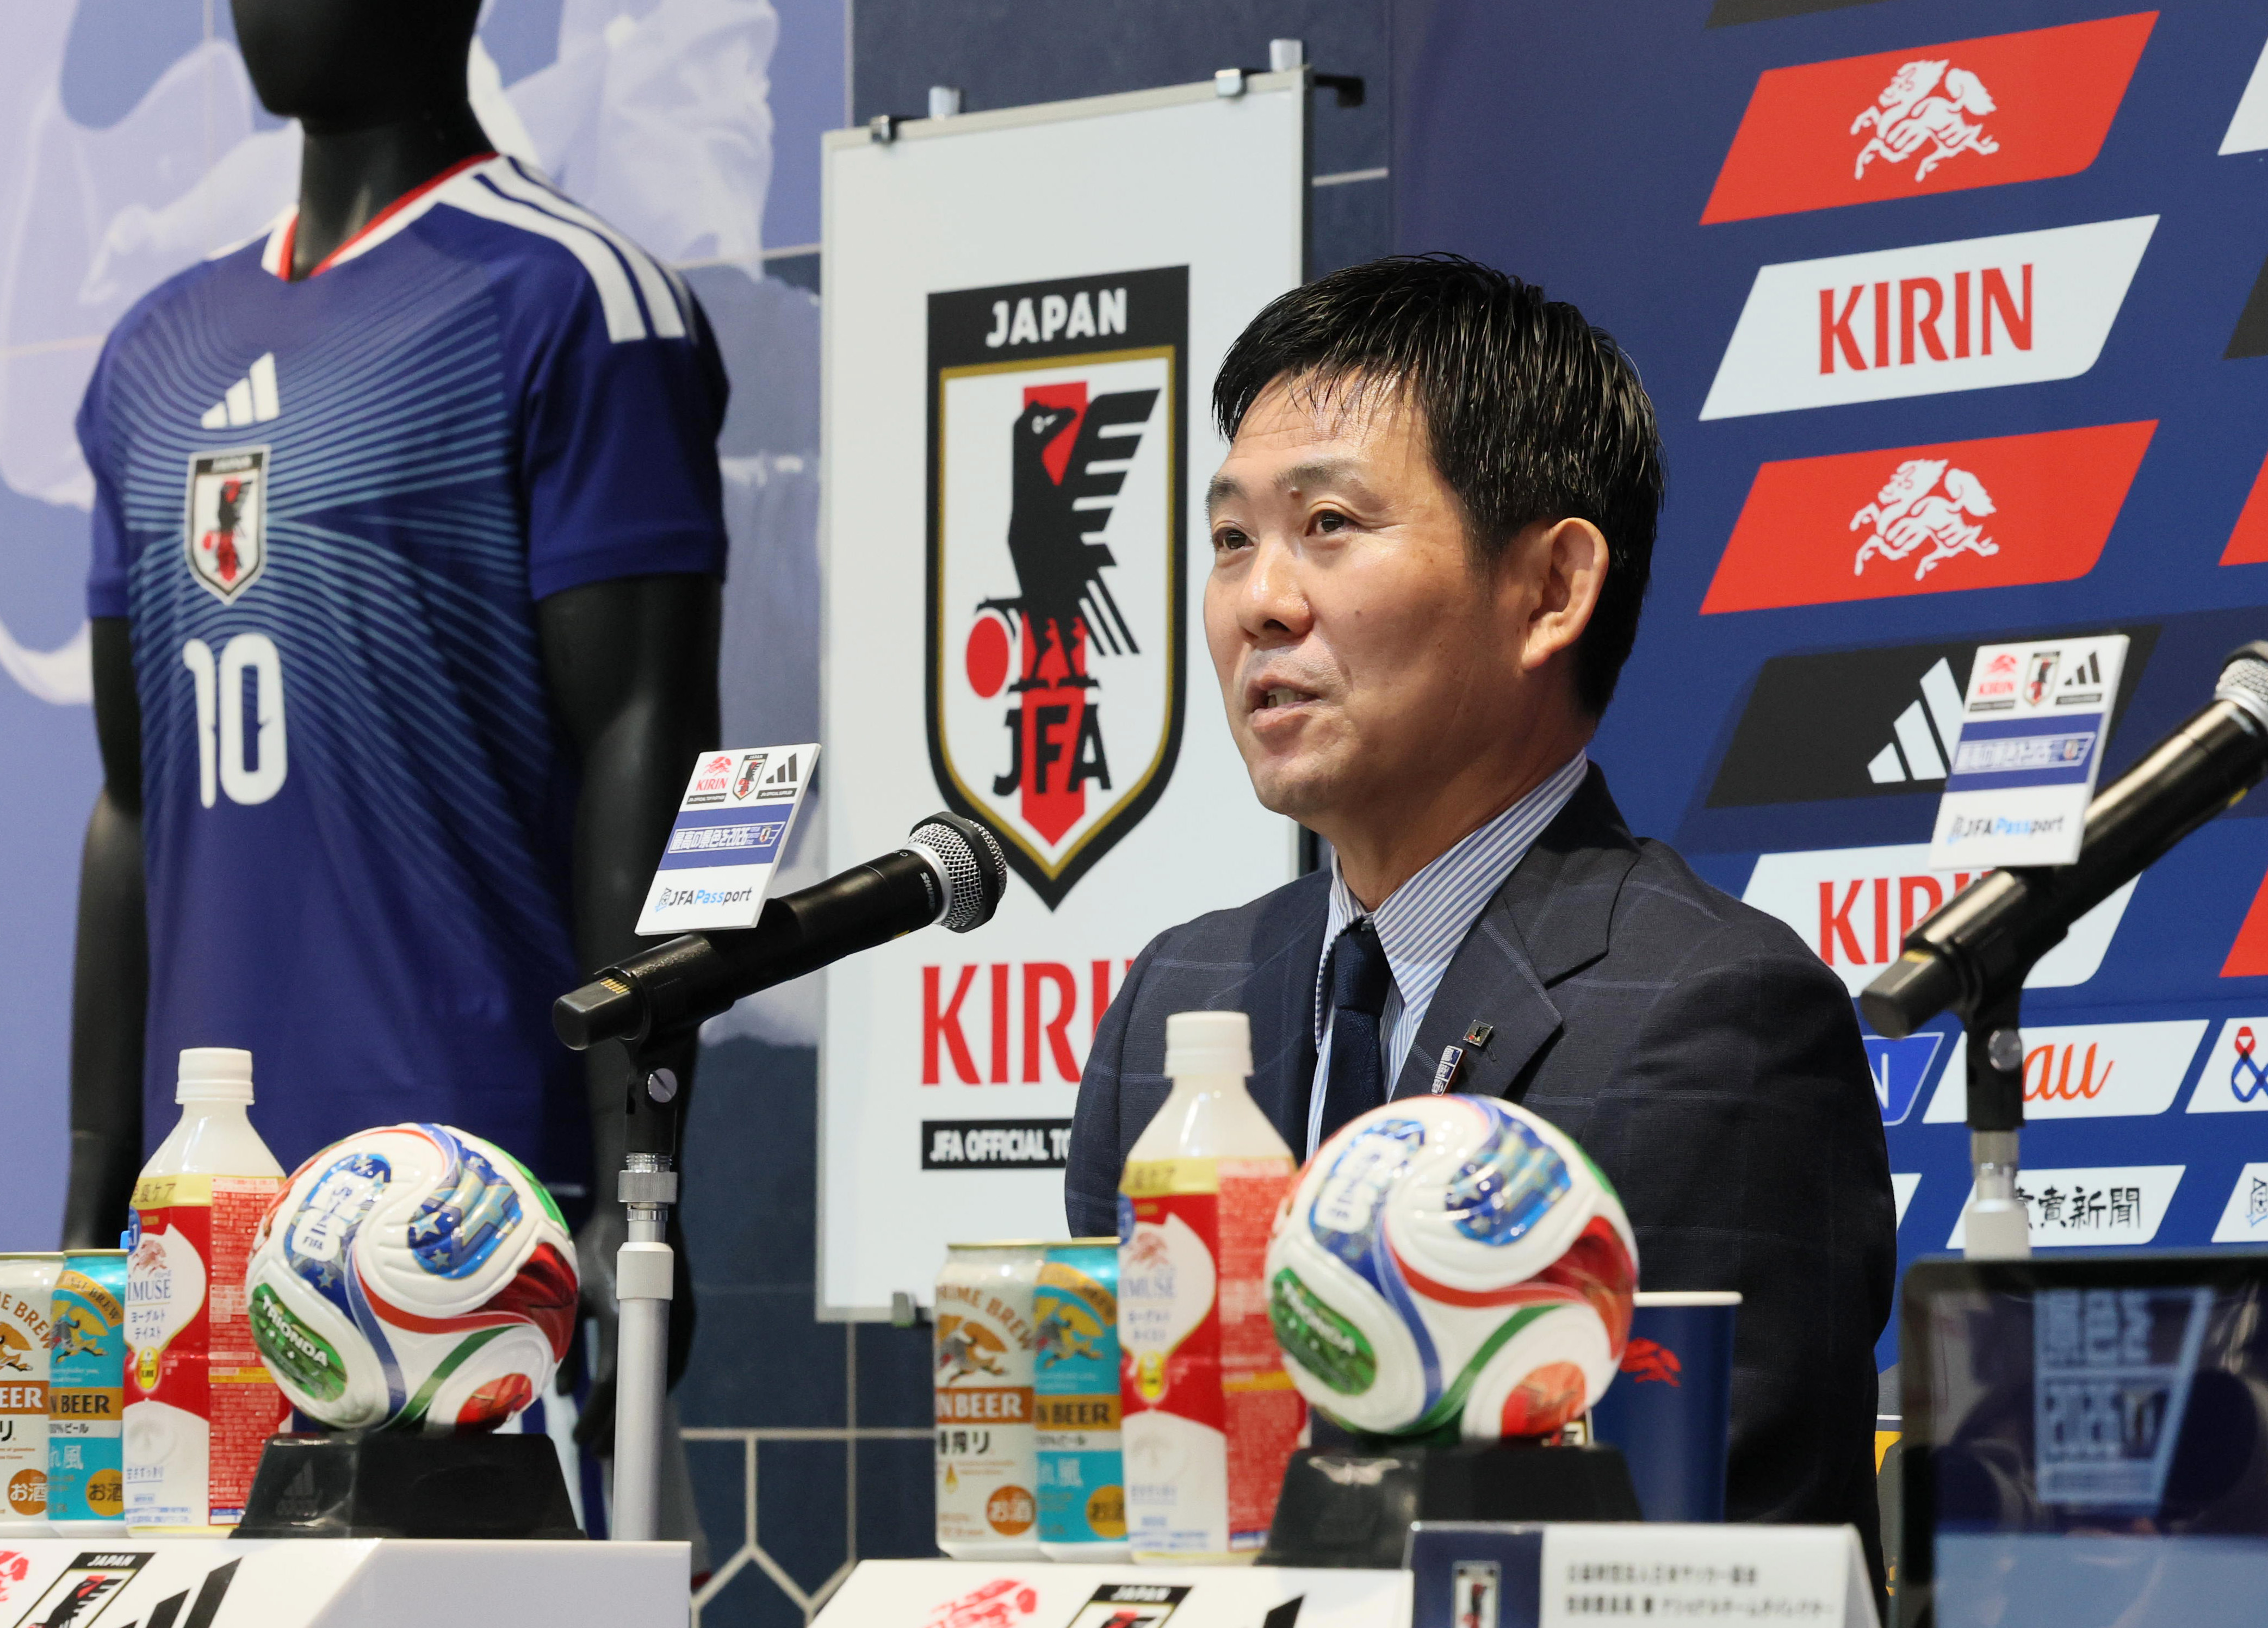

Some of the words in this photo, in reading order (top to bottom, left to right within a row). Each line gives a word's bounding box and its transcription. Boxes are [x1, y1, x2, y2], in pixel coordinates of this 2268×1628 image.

[986, 287, 1128, 348] JAPAN
[1818, 263, 2034, 375] KIRIN
[182, 632, 288, 809] 10
[992, 703, 1113, 797] JFA
[695, 777, 729, 792] KIRIN
[1818, 871, 1998, 966] KIR
[921, 959, 1131, 1085] KIRI
[2022, 1041, 2115, 1102] au
[964, 1128, 1049, 1162] OFFICIAL
[0, 1387, 44, 1409] EER
[61, 1395, 110, 1414] BEER
[955, 1391, 1023, 1419] BEER
[87, 1555, 137, 1567] JAPAN
